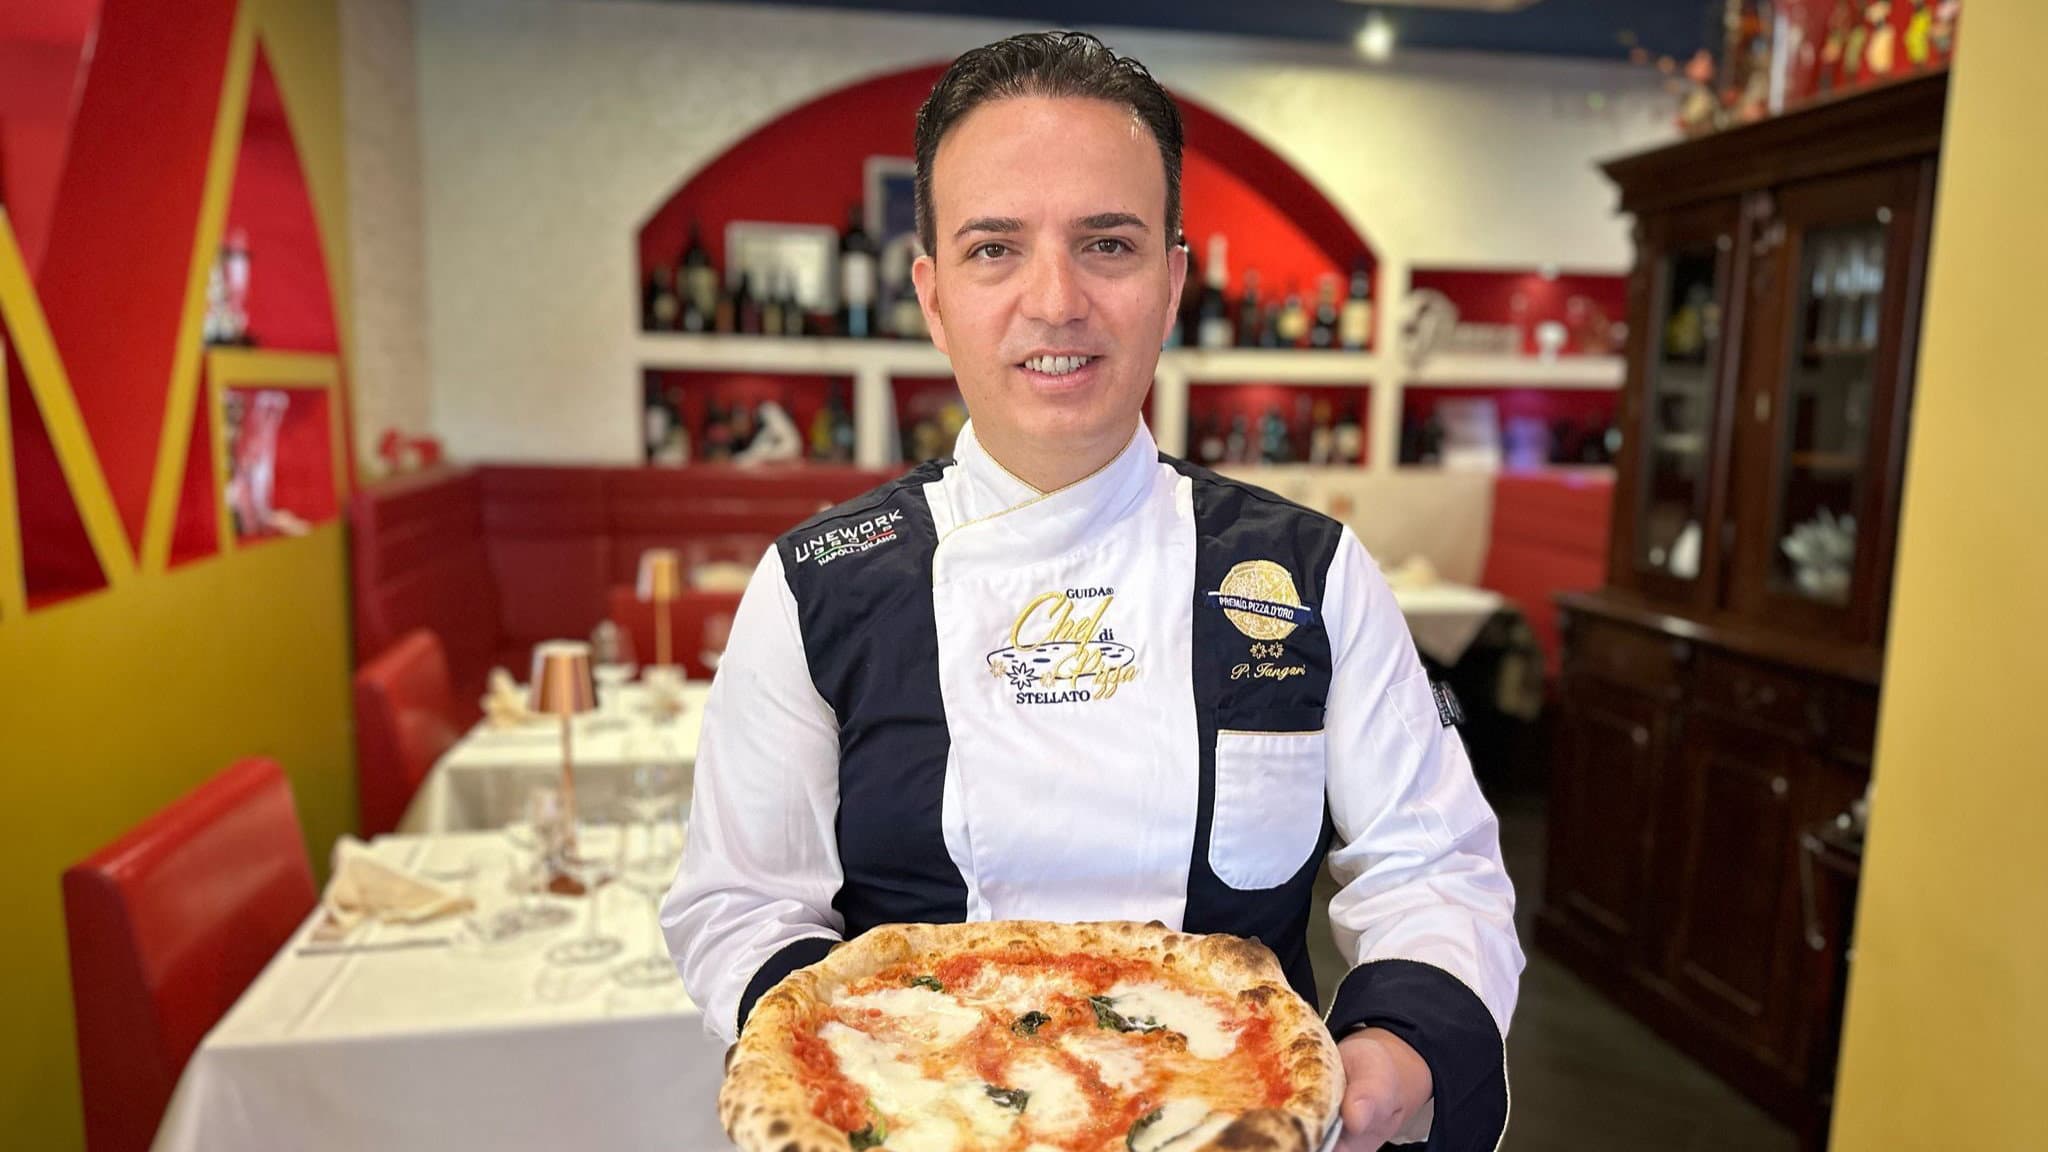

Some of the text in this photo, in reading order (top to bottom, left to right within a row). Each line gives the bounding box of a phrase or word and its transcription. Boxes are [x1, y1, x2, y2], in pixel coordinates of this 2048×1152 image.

[795, 509, 904, 564] UNEWORK
[1219, 597, 1294, 620] PREMIO PIZZA D'ORO
[1011, 592, 1114, 658] Chef
[1099, 628, 1114, 641] di
[1056, 648, 1136, 698] Pizza
[1230, 663, 1249, 679] P.
[1016, 690, 1091, 705] STELLATO
